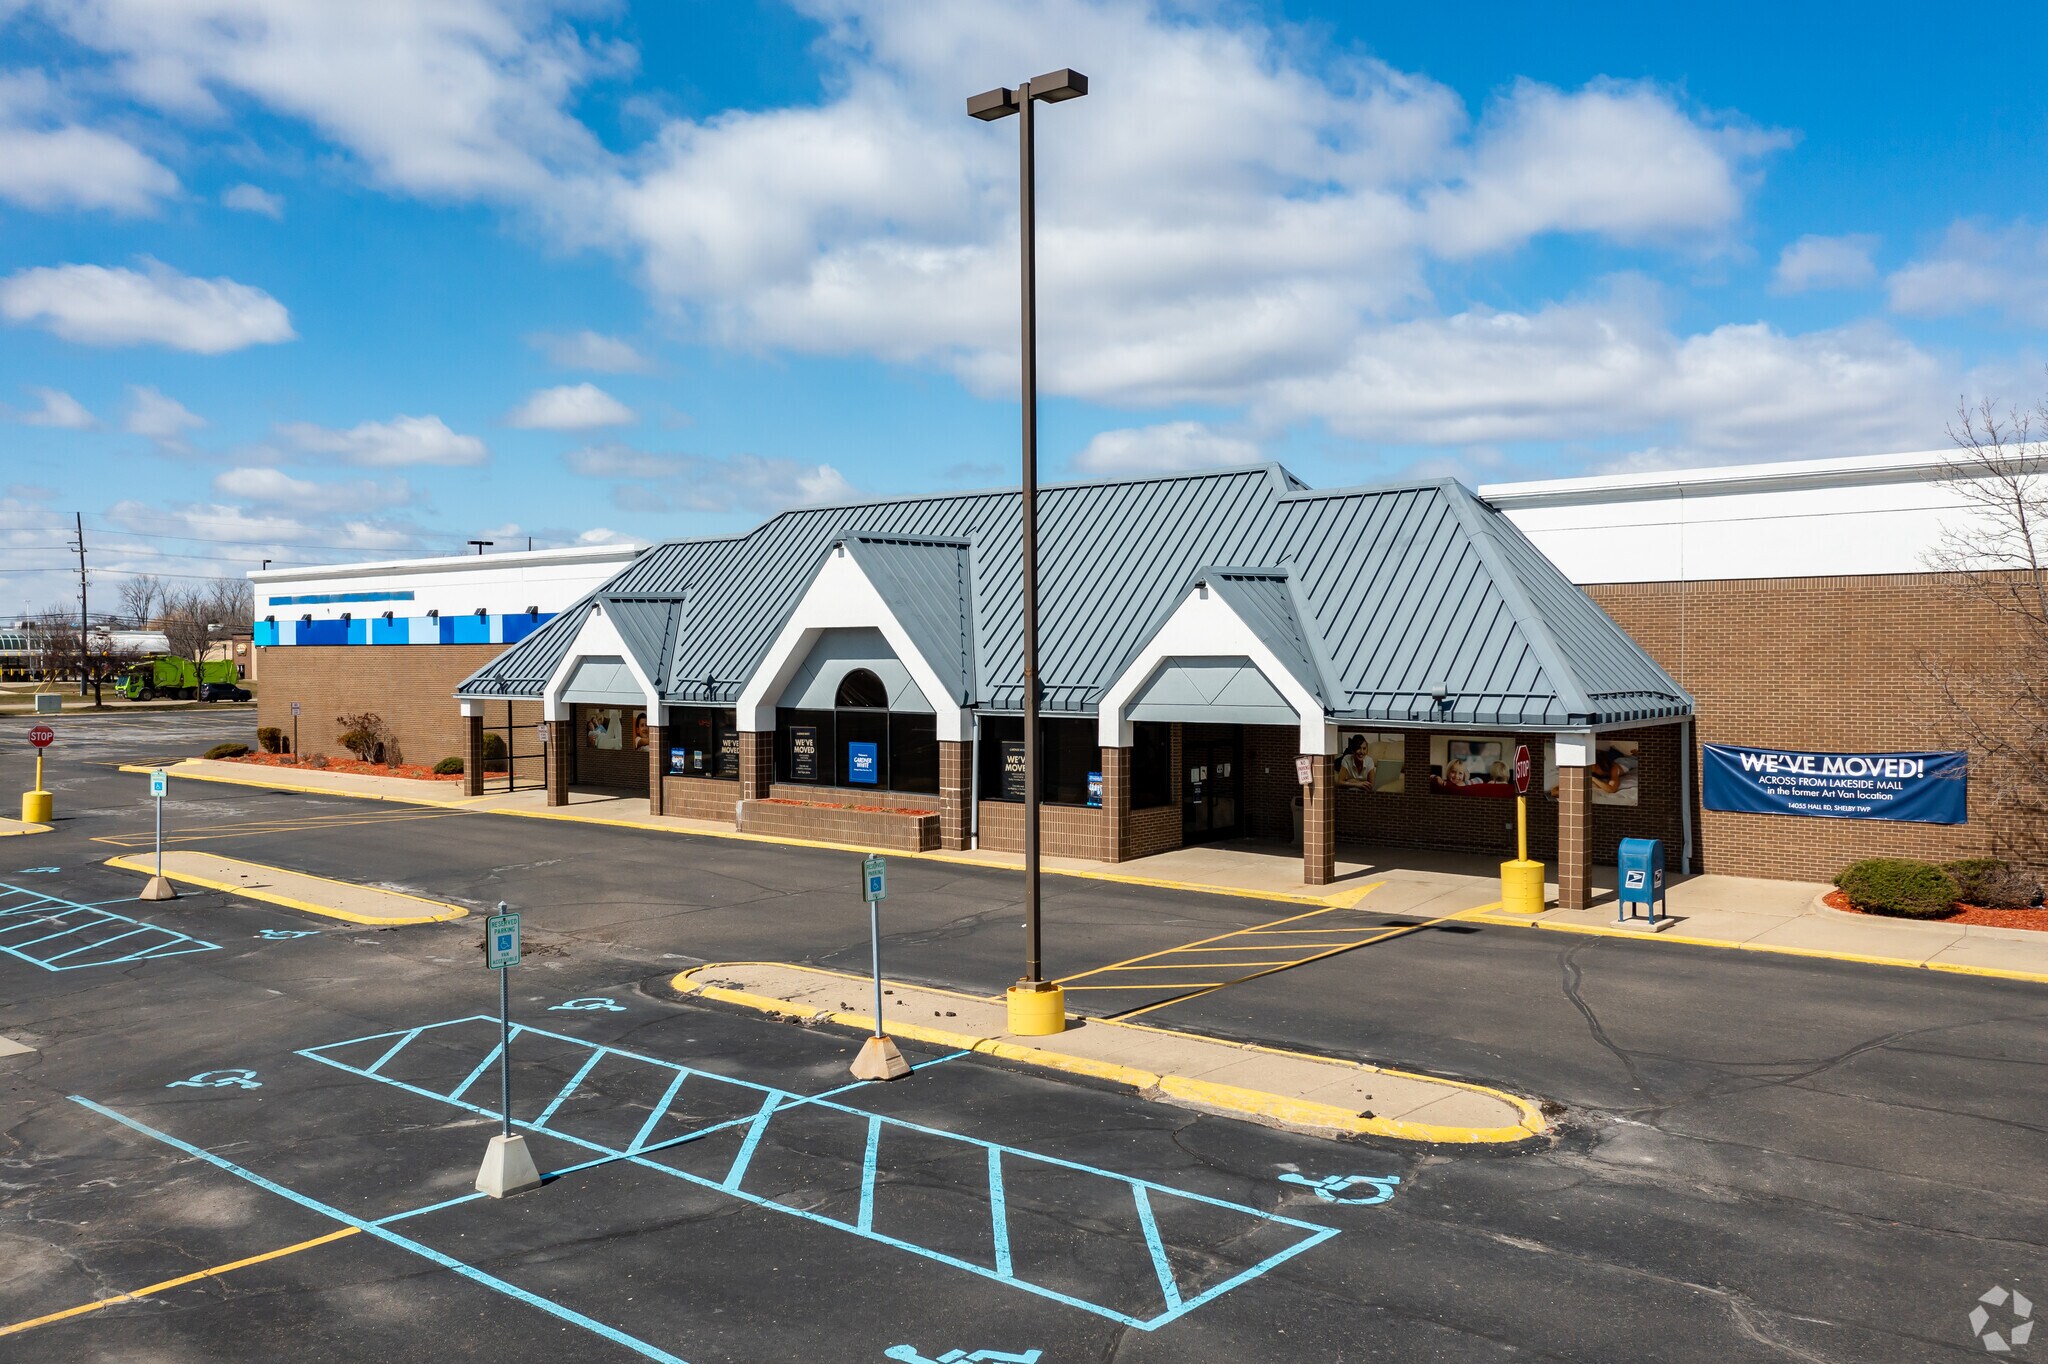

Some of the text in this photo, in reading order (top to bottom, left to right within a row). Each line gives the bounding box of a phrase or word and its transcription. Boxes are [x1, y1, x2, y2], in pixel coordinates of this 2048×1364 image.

[30, 731, 53, 741] STOP
[795, 738, 814, 747] WE'VE
[793, 746, 815, 754] MOVED
[1006, 755, 1025, 764] WE'V
[1004, 763, 1025, 772] MOVE
[1517, 760, 1529, 779] STOP
[1740, 753, 1924, 779] WE'VE MOVED!
[1758, 776, 1903, 790] ACROSS FROM LAKESIDE MALL
[1767, 787, 1893, 800] in the former Art Van location
[491, 918, 517, 928] RESERVED
[494, 926, 516, 934] PARKING
